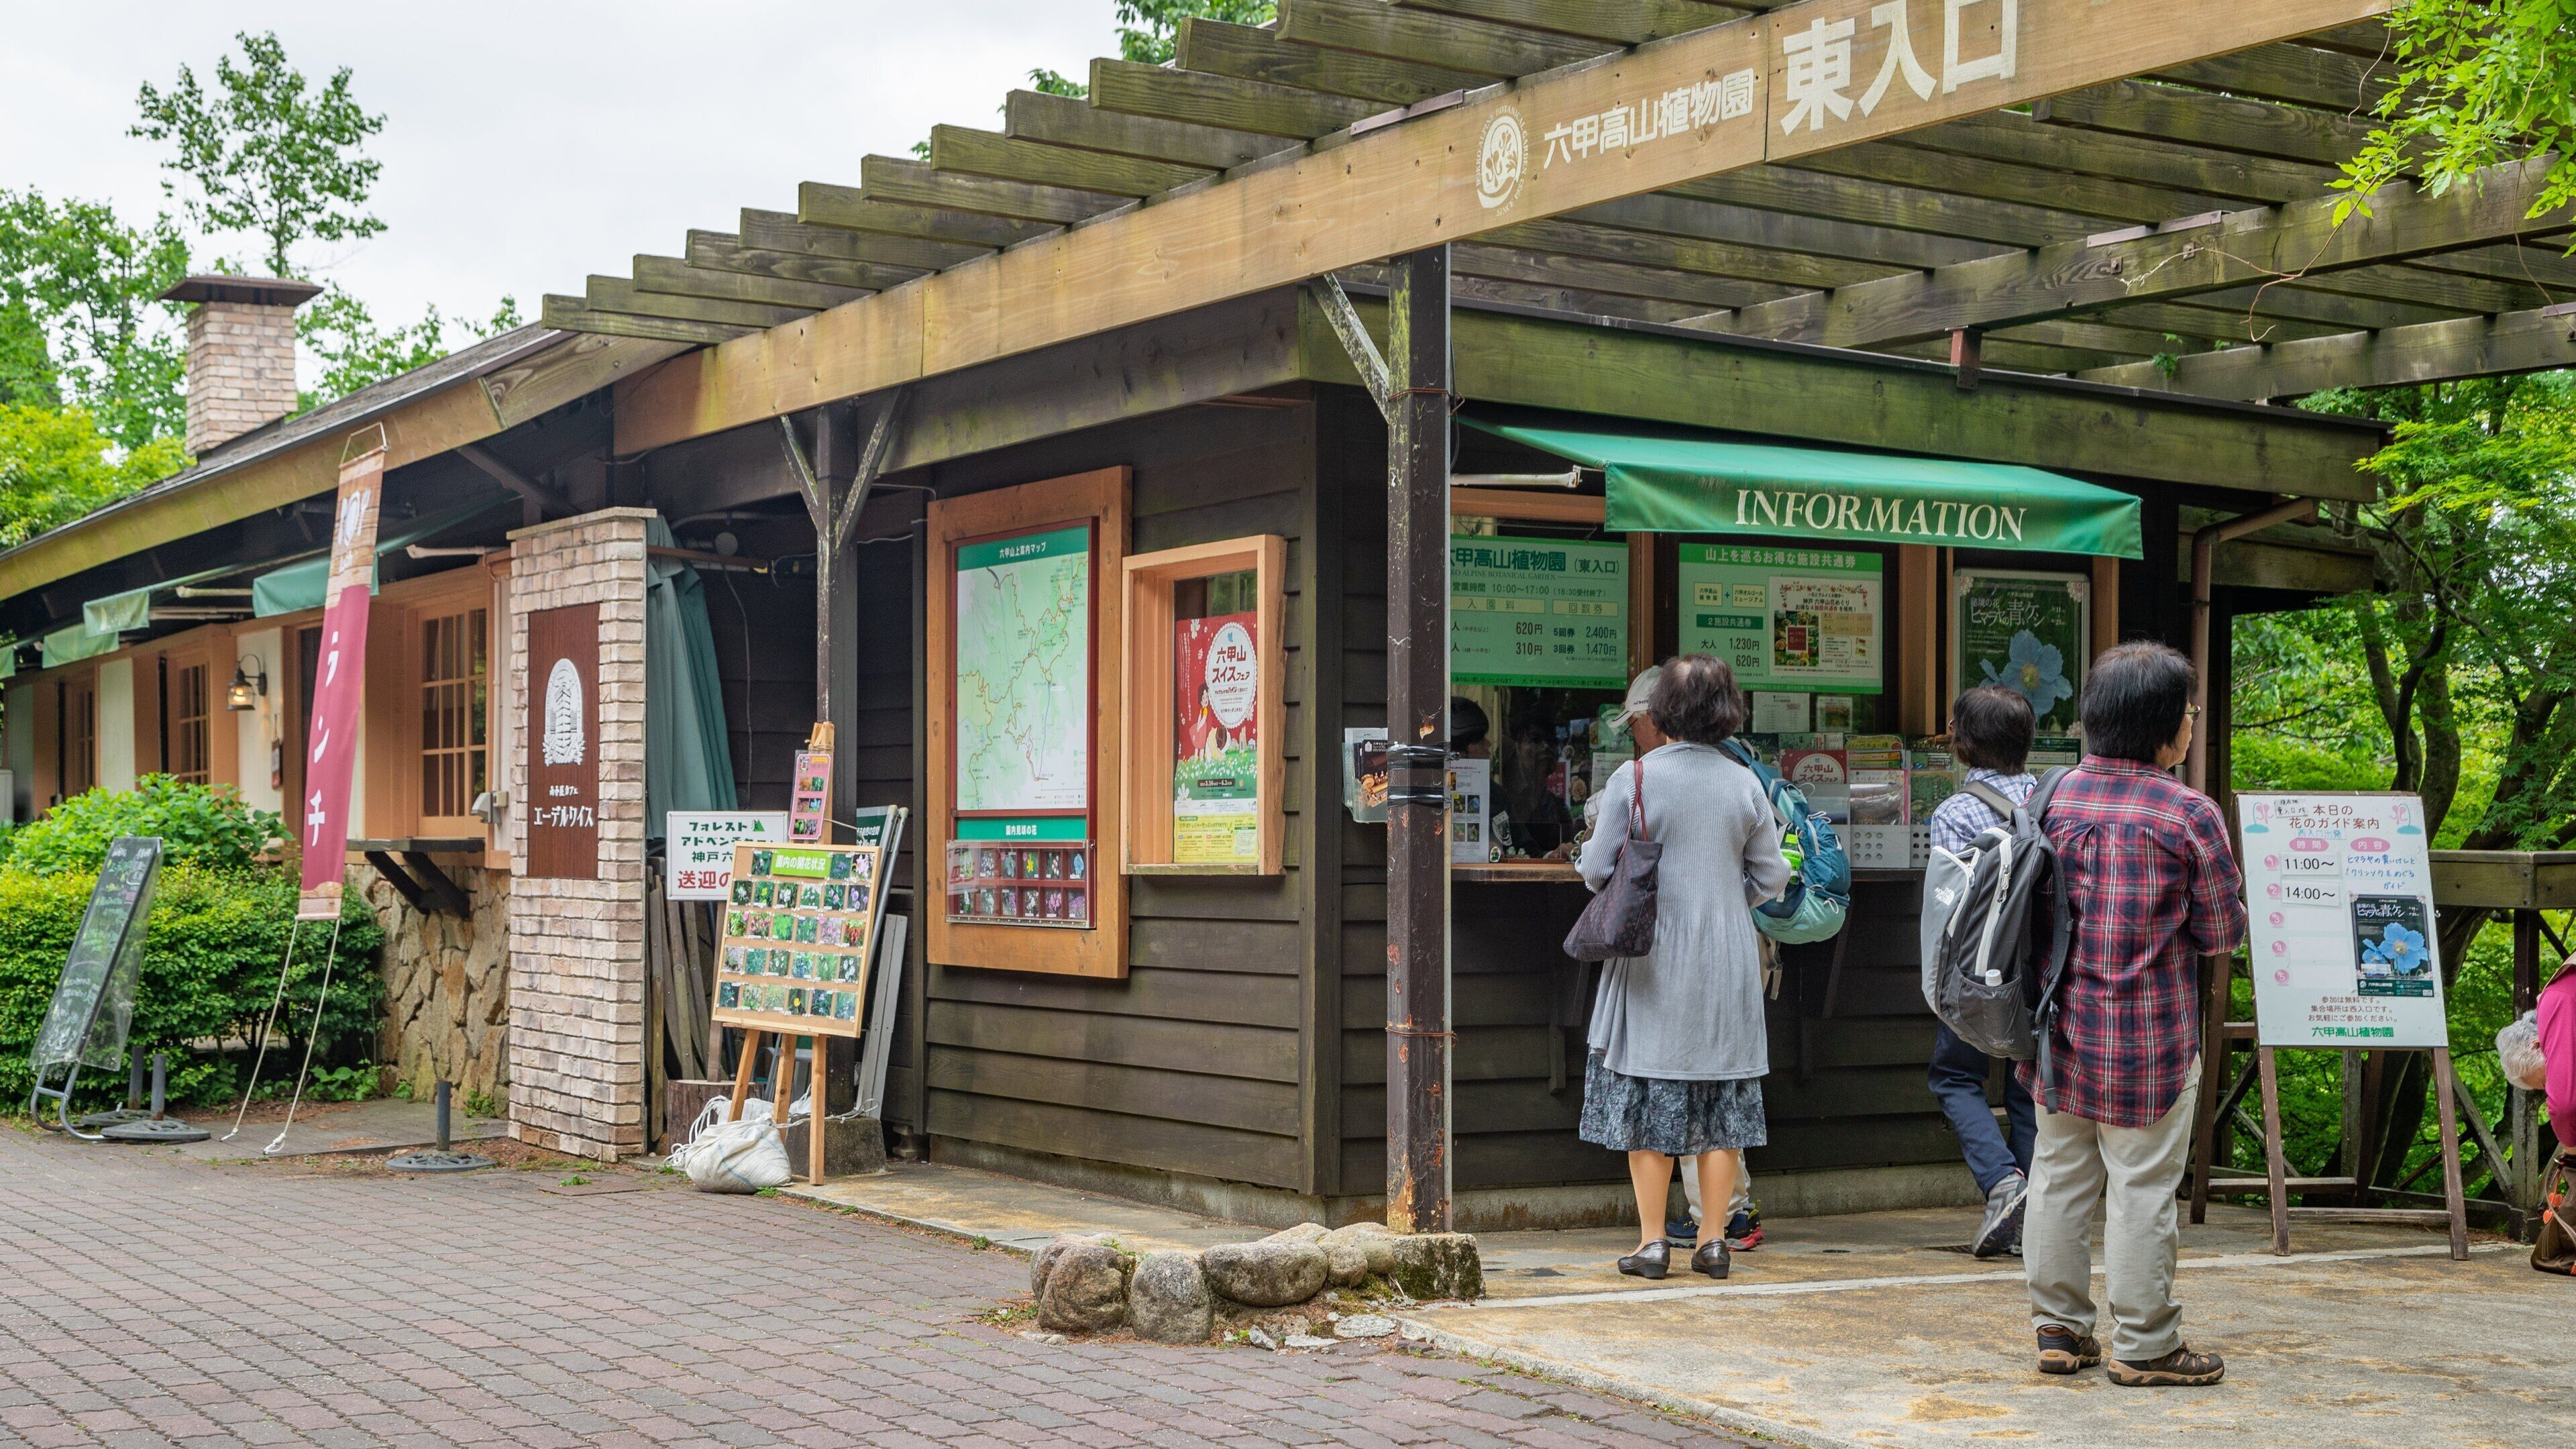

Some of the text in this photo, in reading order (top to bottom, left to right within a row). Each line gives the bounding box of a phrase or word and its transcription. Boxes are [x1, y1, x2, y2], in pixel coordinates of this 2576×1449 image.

[1780, 0, 2018, 137] 東入口
[1544, 68, 1755, 169] 六甲高山植物園
[1479, 112, 1494, 149] ALPINE
[1496, 105, 1525, 131] BOTANICAL
[1496, 199, 1514, 217] SINCE
[1735, 489, 2027, 541] INFORMATION
[999, 542, 1046, 558] 六甲山上案内マップ
[1705, 548, 1856, 569] 山上を巡るお得な施設共通券
[1452, 582, 1486, 592] 営業時間
[1467, 599, 1515, 610] 入園料
[1568, 602, 1603, 614] 回数券
[1971, 600, 2045, 627] ヒマラヤの青いケシ
[1516, 622, 1543, 635] 620円
[1554, 627, 1617, 639] 5回券 2,400円
[1515, 642, 1543, 655] 310円
[1554, 643, 1617, 656] 3回券 1,470円
[1701, 637, 1760, 651] 大人 1,230円
[1216, 645, 1246, 664] 六甲山
[1735, 655, 1760, 667] 620円
[1212, 666, 1250, 683] スイスフェア
[307, 631, 341, 847] ランチ
[1803, 765, 1833, 773] 六甲山
[1799, 773, 1838, 782] スイスフェア
[534, 805, 594, 827] エーデルワイス
[2313, 804, 2353, 816] 本日の
[689, 822, 747, 832] フォレスト
[2289, 816, 2379, 830] 花のガイド案内
[1006, 825, 1037, 835] 園内見頃の花
[2297, 841, 2321, 849] 時間
[2358, 841, 2383, 850] 内容
[775, 855, 826, 871] 園内の開花状況
[2383, 882, 2404, 890] ガイド
[2357, 904, 2405, 917] ヒマラヤの青いケシ
[2322, 996, 2380, 1004] 参加は無料です。
[2312, 1026, 2394, 1037] 六甲高山植物園
